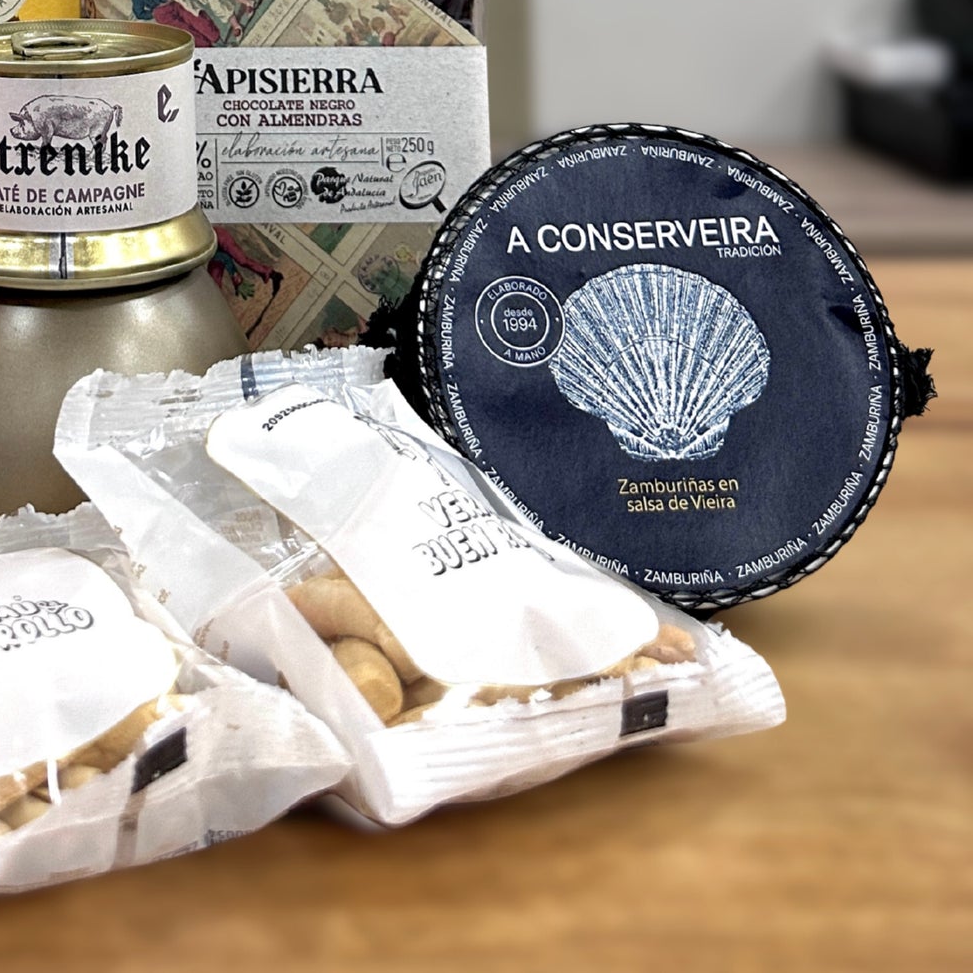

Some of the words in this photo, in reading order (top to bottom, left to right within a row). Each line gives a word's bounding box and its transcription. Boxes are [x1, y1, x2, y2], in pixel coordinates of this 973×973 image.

[222, 99, 304, 111] CHOCOLATE
[310, 99, 356, 111] NEGRO
[216, 113, 251, 128] CON
[258, 113, 363, 127] ALMENDRAS
[401, 136, 425, 153] 250
[427, 140, 435, 156] g
[556, 145, 628, 169] ZAMBURIÑA
[640, 145, 716, 169] ZAMBURIÑA
[27, 188, 47, 203] DE
[53, 182, 145, 203] CAMPAGNE
[489, 166, 549, 213] ZAMBURIÑA
[727, 165, 795, 214] ZAMBURIÑA
[0, 204, 72, 216] ELABORACIÓN
[77, 202, 134, 216] ARTESANAL
[507, 226, 531, 253] A
[537, 215, 779, 253] CONSERVEIRA
[448, 217, 488, 282] ZAMBURIÑA
[716, 244, 781, 259] TRADICIÓN
[800, 216, 854, 285] ZAMBURIÑA
[487, 281, 547, 301] ELABORADO
[504, 307, 533, 317] desde
[440, 293, 455, 370] ZAMBURIÑA
[502, 317, 538, 332] 1994
[852, 293, 882, 372] ZAMBURIÑA
[504, 348, 511, 358] A
[515, 346, 546, 361] MANO
[446, 382, 483, 459] ZAMBURIÑA
[858, 385, 883, 462] ZAMBURIÑA
[617, 477, 715, 495] Zamburiñas
[718, 478, 739, 492] en
[627, 495, 665, 512] salsa
[668, 494, 689, 510] de
[690, 493, 736, 509] Vieira
[811, 470, 864, 535] ZAMBURIÑA
[412, 523, 498, 576] BUEN
[735, 537, 808, 578] ZAMBURIÑA
[643, 568, 724, 586] ZAMBURIÑA
